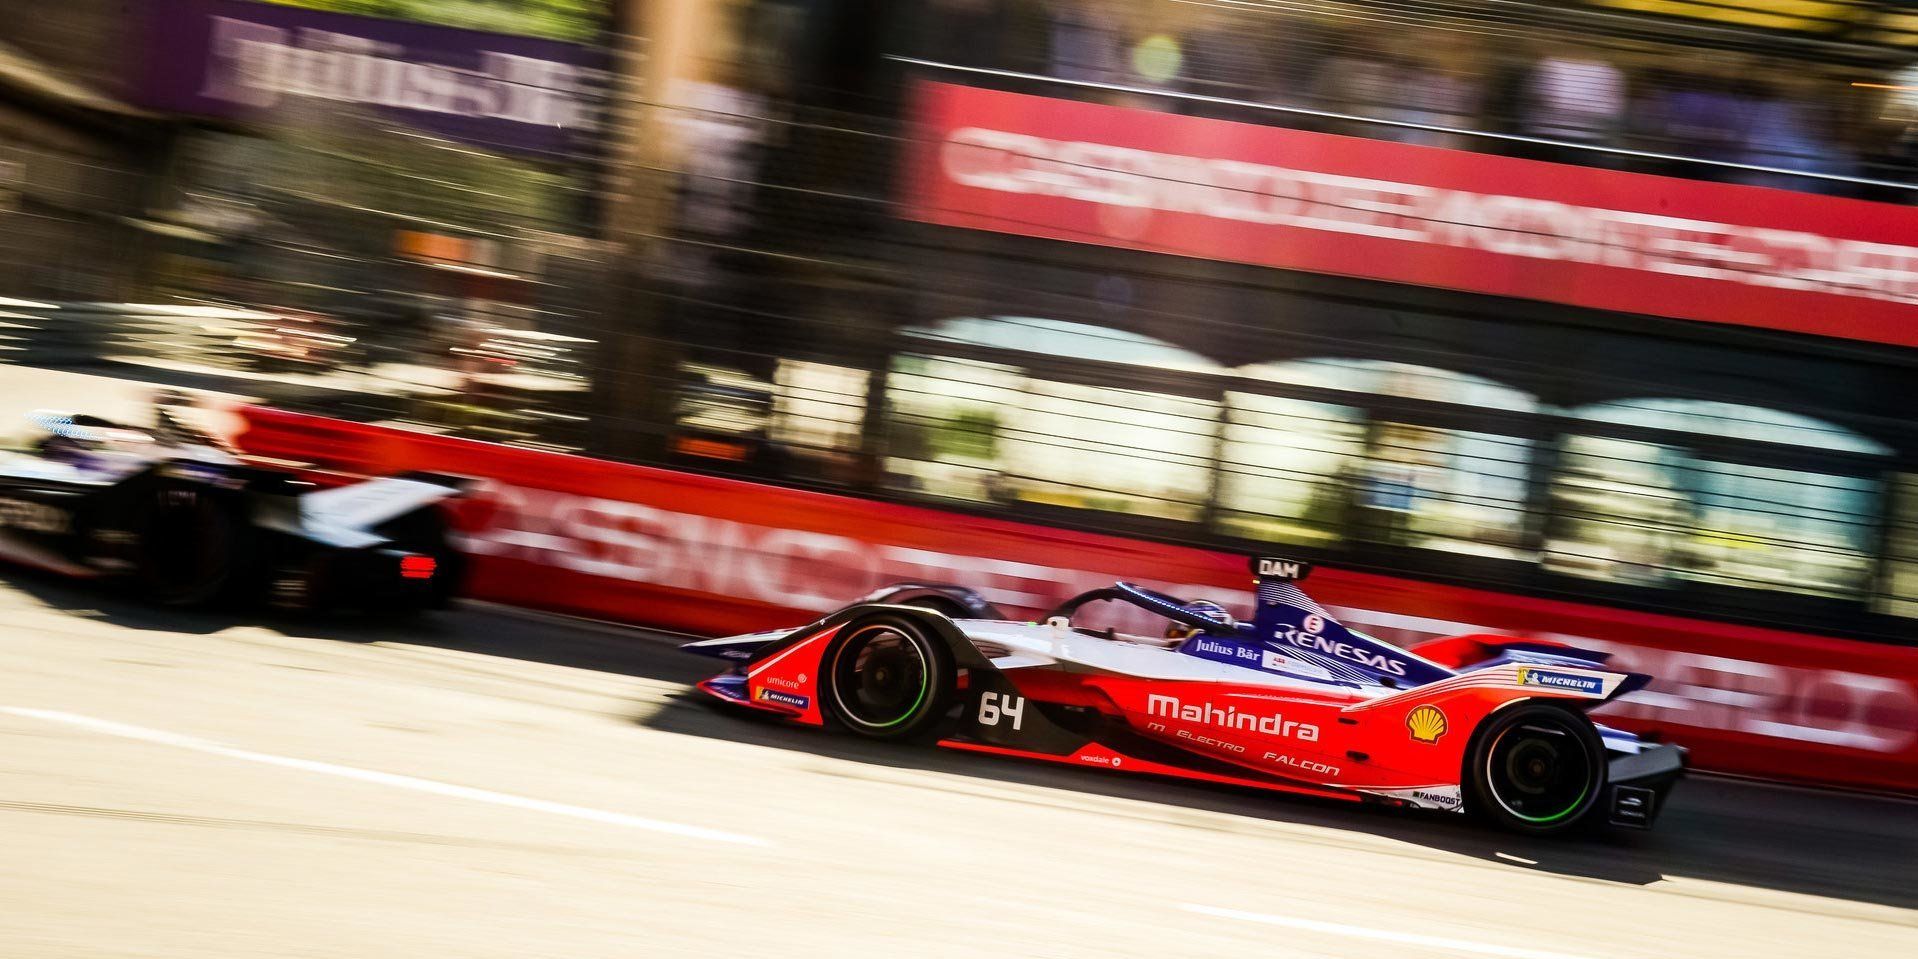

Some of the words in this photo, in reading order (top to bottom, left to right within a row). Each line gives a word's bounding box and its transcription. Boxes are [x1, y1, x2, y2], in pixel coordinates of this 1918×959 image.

[1259, 560, 1299, 578] DAM
[1196, 639, 1233, 655] Julius
[1273, 623, 1406, 676] RENESAS
[767, 676, 799, 689] umicore
[1541, 676, 1596, 688] MICHELIN
[770, 694, 804, 705] MICHELIN
[978, 691, 1025, 730] 64
[1176, 729, 1246, 753] ELECTRO
[1263, 752, 1340, 776] FALCON
[1419, 792, 1460, 806] FANBOOST
